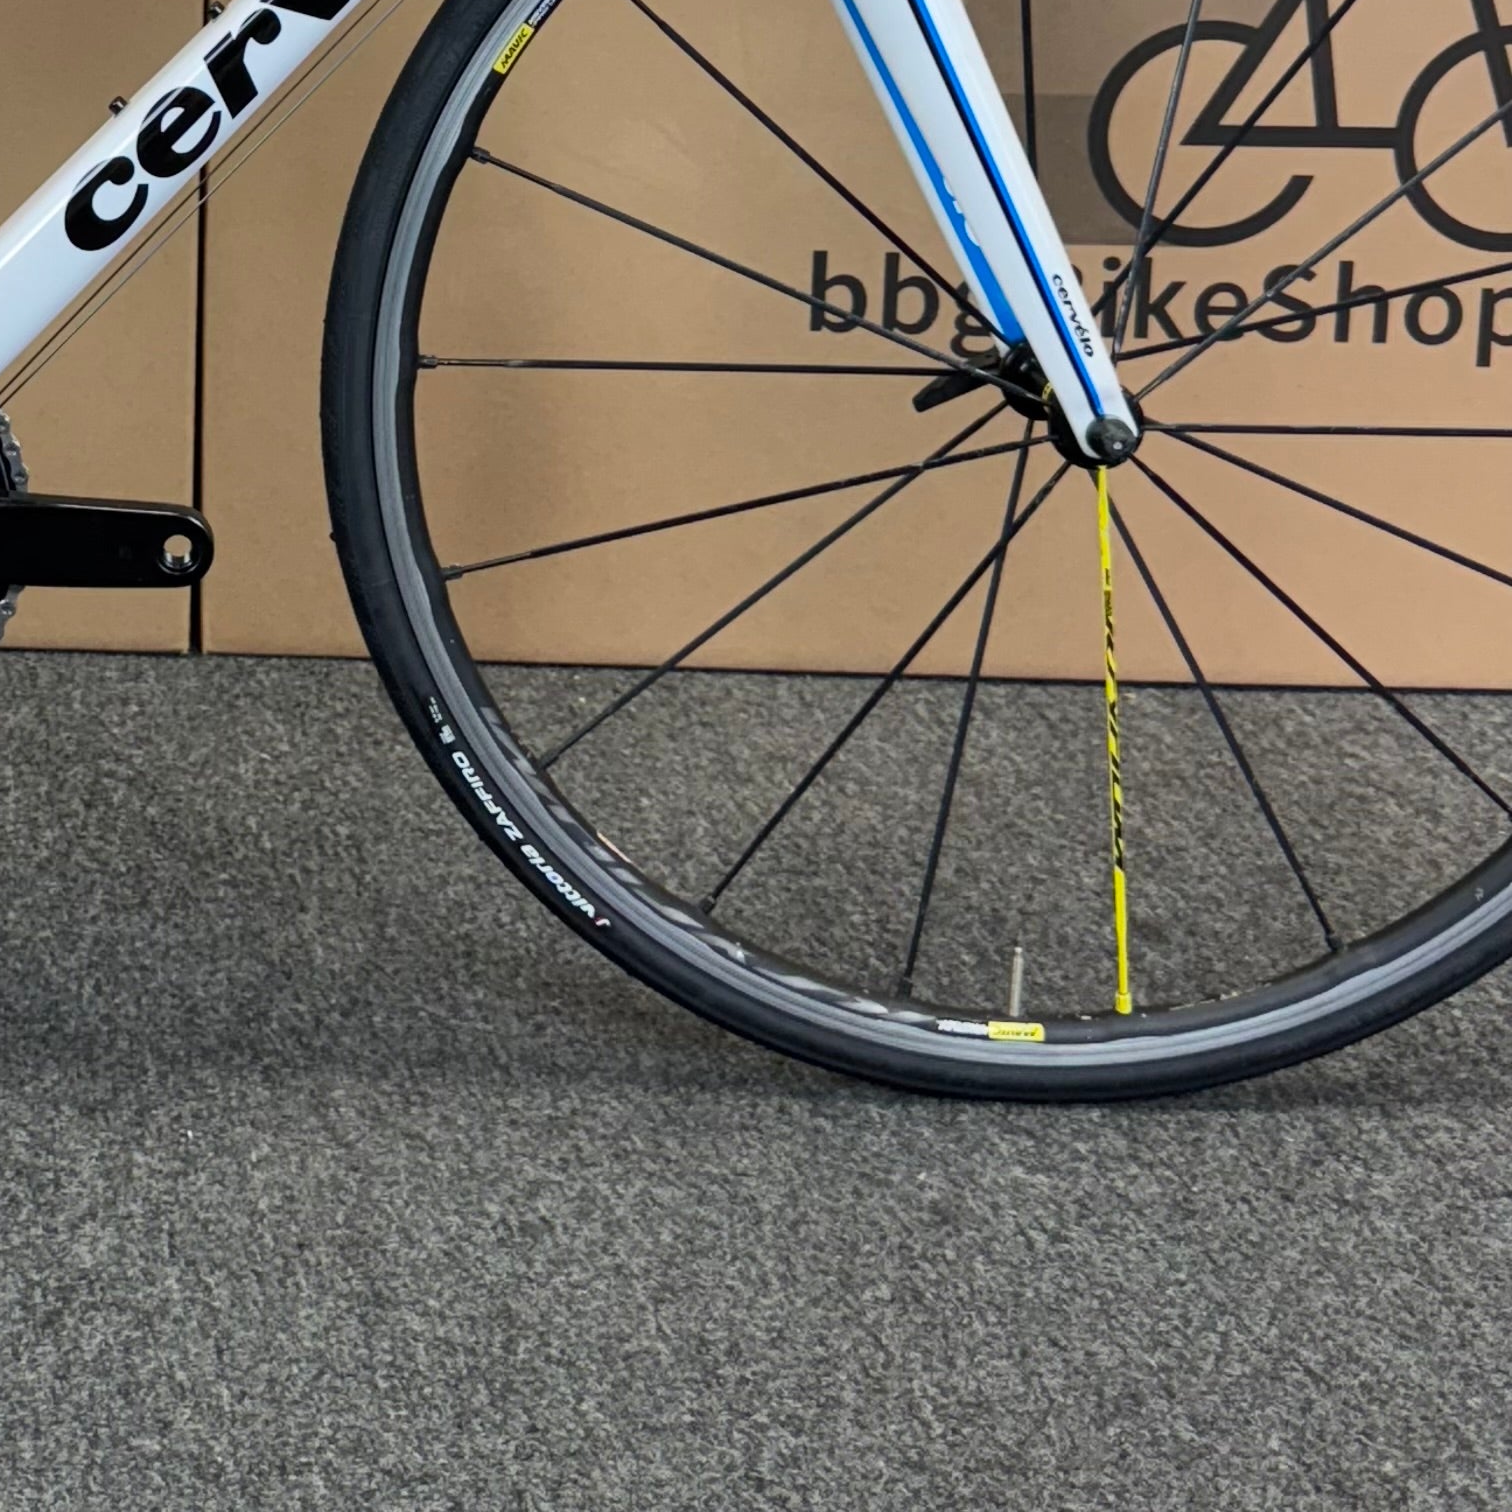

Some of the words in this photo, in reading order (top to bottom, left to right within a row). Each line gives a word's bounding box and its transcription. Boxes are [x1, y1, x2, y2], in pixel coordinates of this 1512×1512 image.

[1051, 273, 1095, 358] cervélo
[451, 750, 525, 842] ZAFFIRO
[519, 843, 597, 919] vittoria
